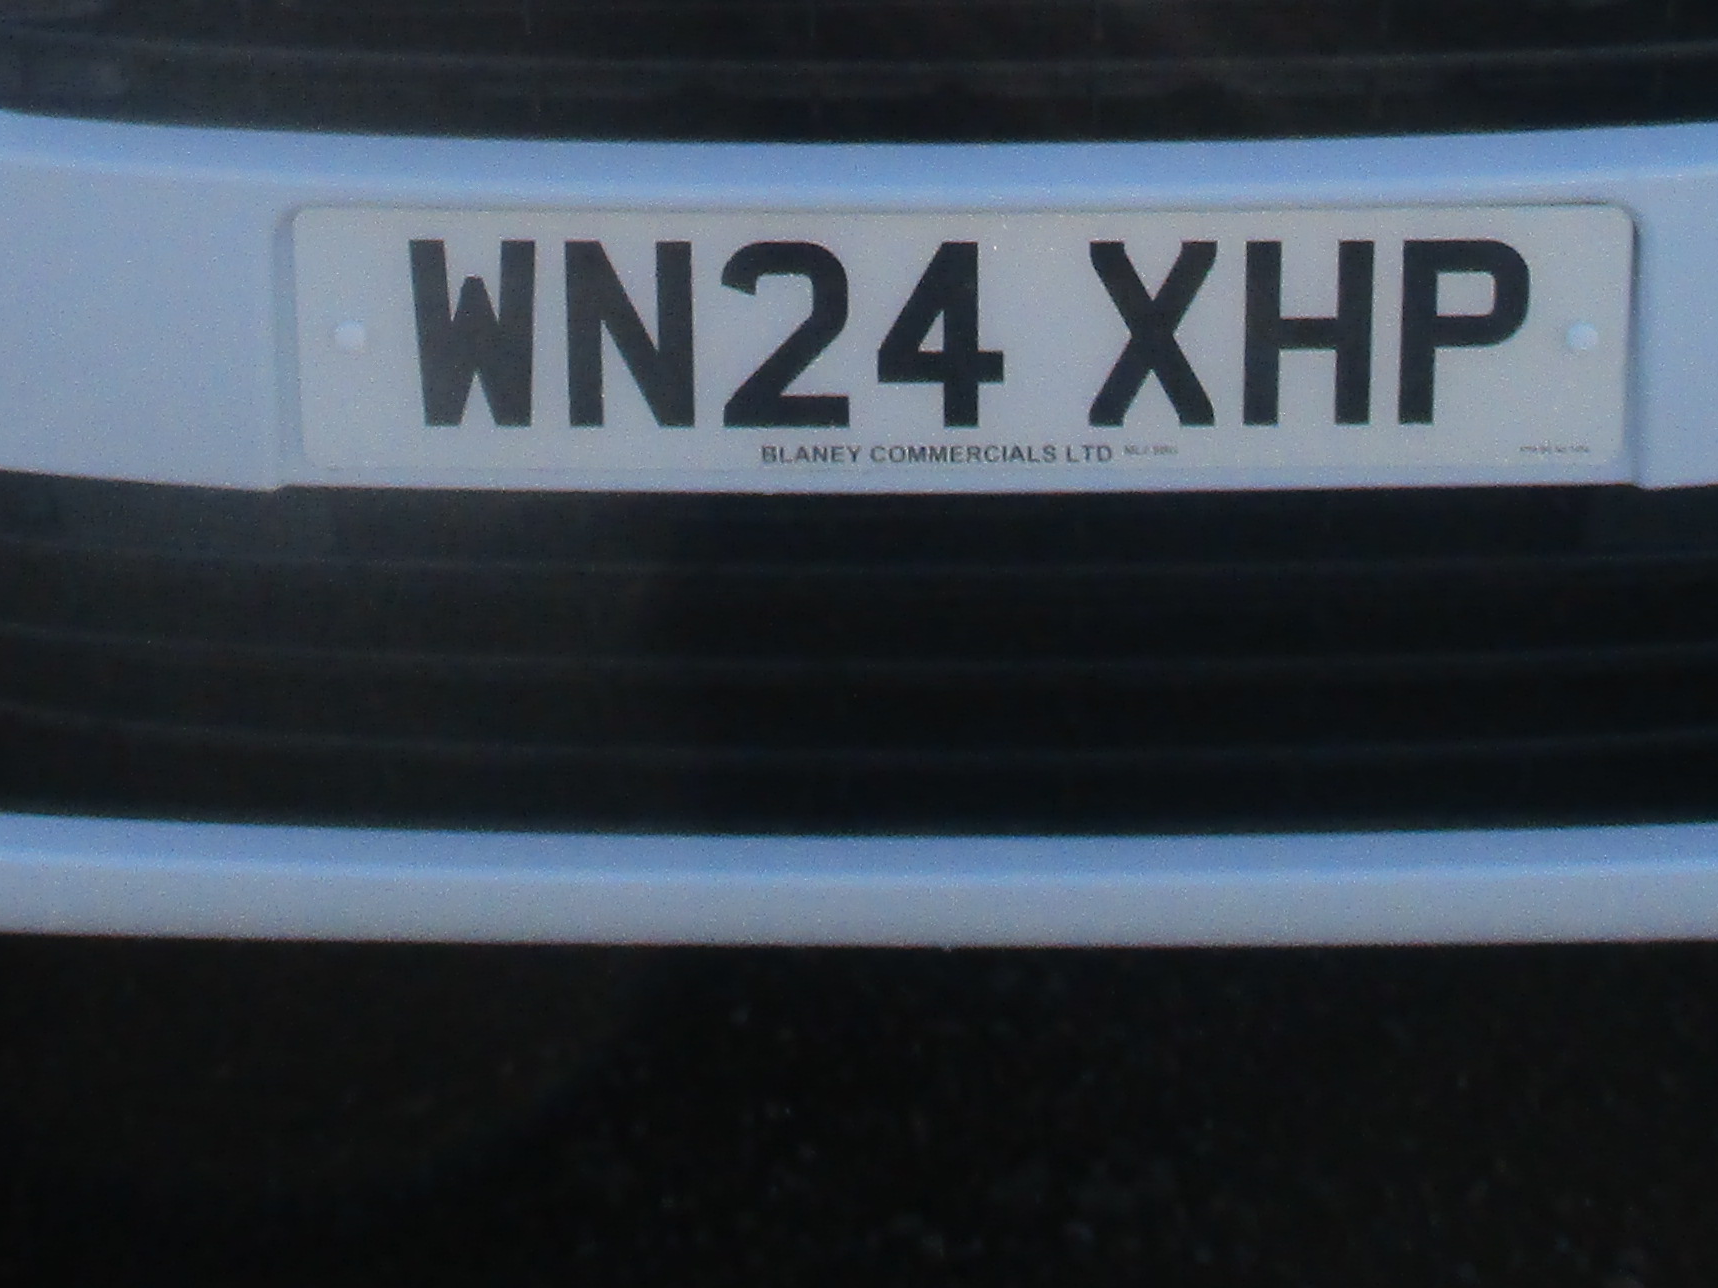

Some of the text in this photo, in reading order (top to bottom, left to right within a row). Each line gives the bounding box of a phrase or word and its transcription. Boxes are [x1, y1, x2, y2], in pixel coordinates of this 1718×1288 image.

[408, 239, 1531, 429] WN24 XHP
[761, 445, 863, 464] BLANEY
[870, 444, 1058, 464] COMMERCIALS
[1066, 444, 1114, 463] LTD
